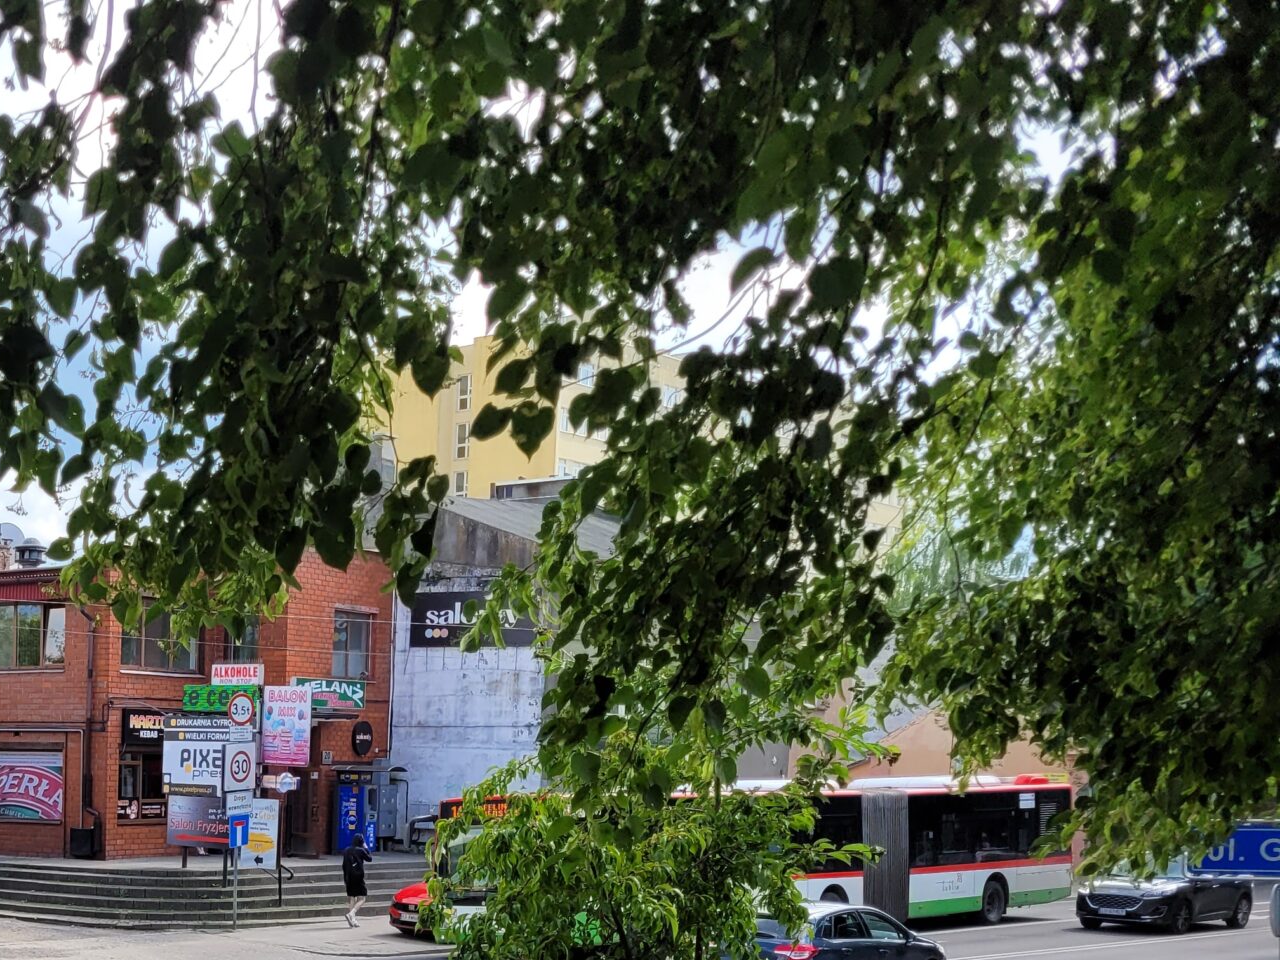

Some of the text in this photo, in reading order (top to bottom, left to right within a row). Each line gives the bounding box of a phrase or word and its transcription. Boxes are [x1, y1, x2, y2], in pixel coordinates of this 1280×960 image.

[214, 666, 258, 678] ALKOHOLE
[268, 690, 308, 703] BALON
[231, 703, 250, 717] 3,5t
[277, 707, 297, 718] MIX
[176, 718, 211, 728] DRUKARNIA
[140, 730, 158, 738] KEBAB
[185, 732, 206, 741] WIELKI
[207, 732, 230, 741] FORMA
[180, 748, 222, 769] PIXE
[324, 751, 332, 760] 20
[233, 759, 248, 775] 30
[170, 818, 195, 831] Salon
